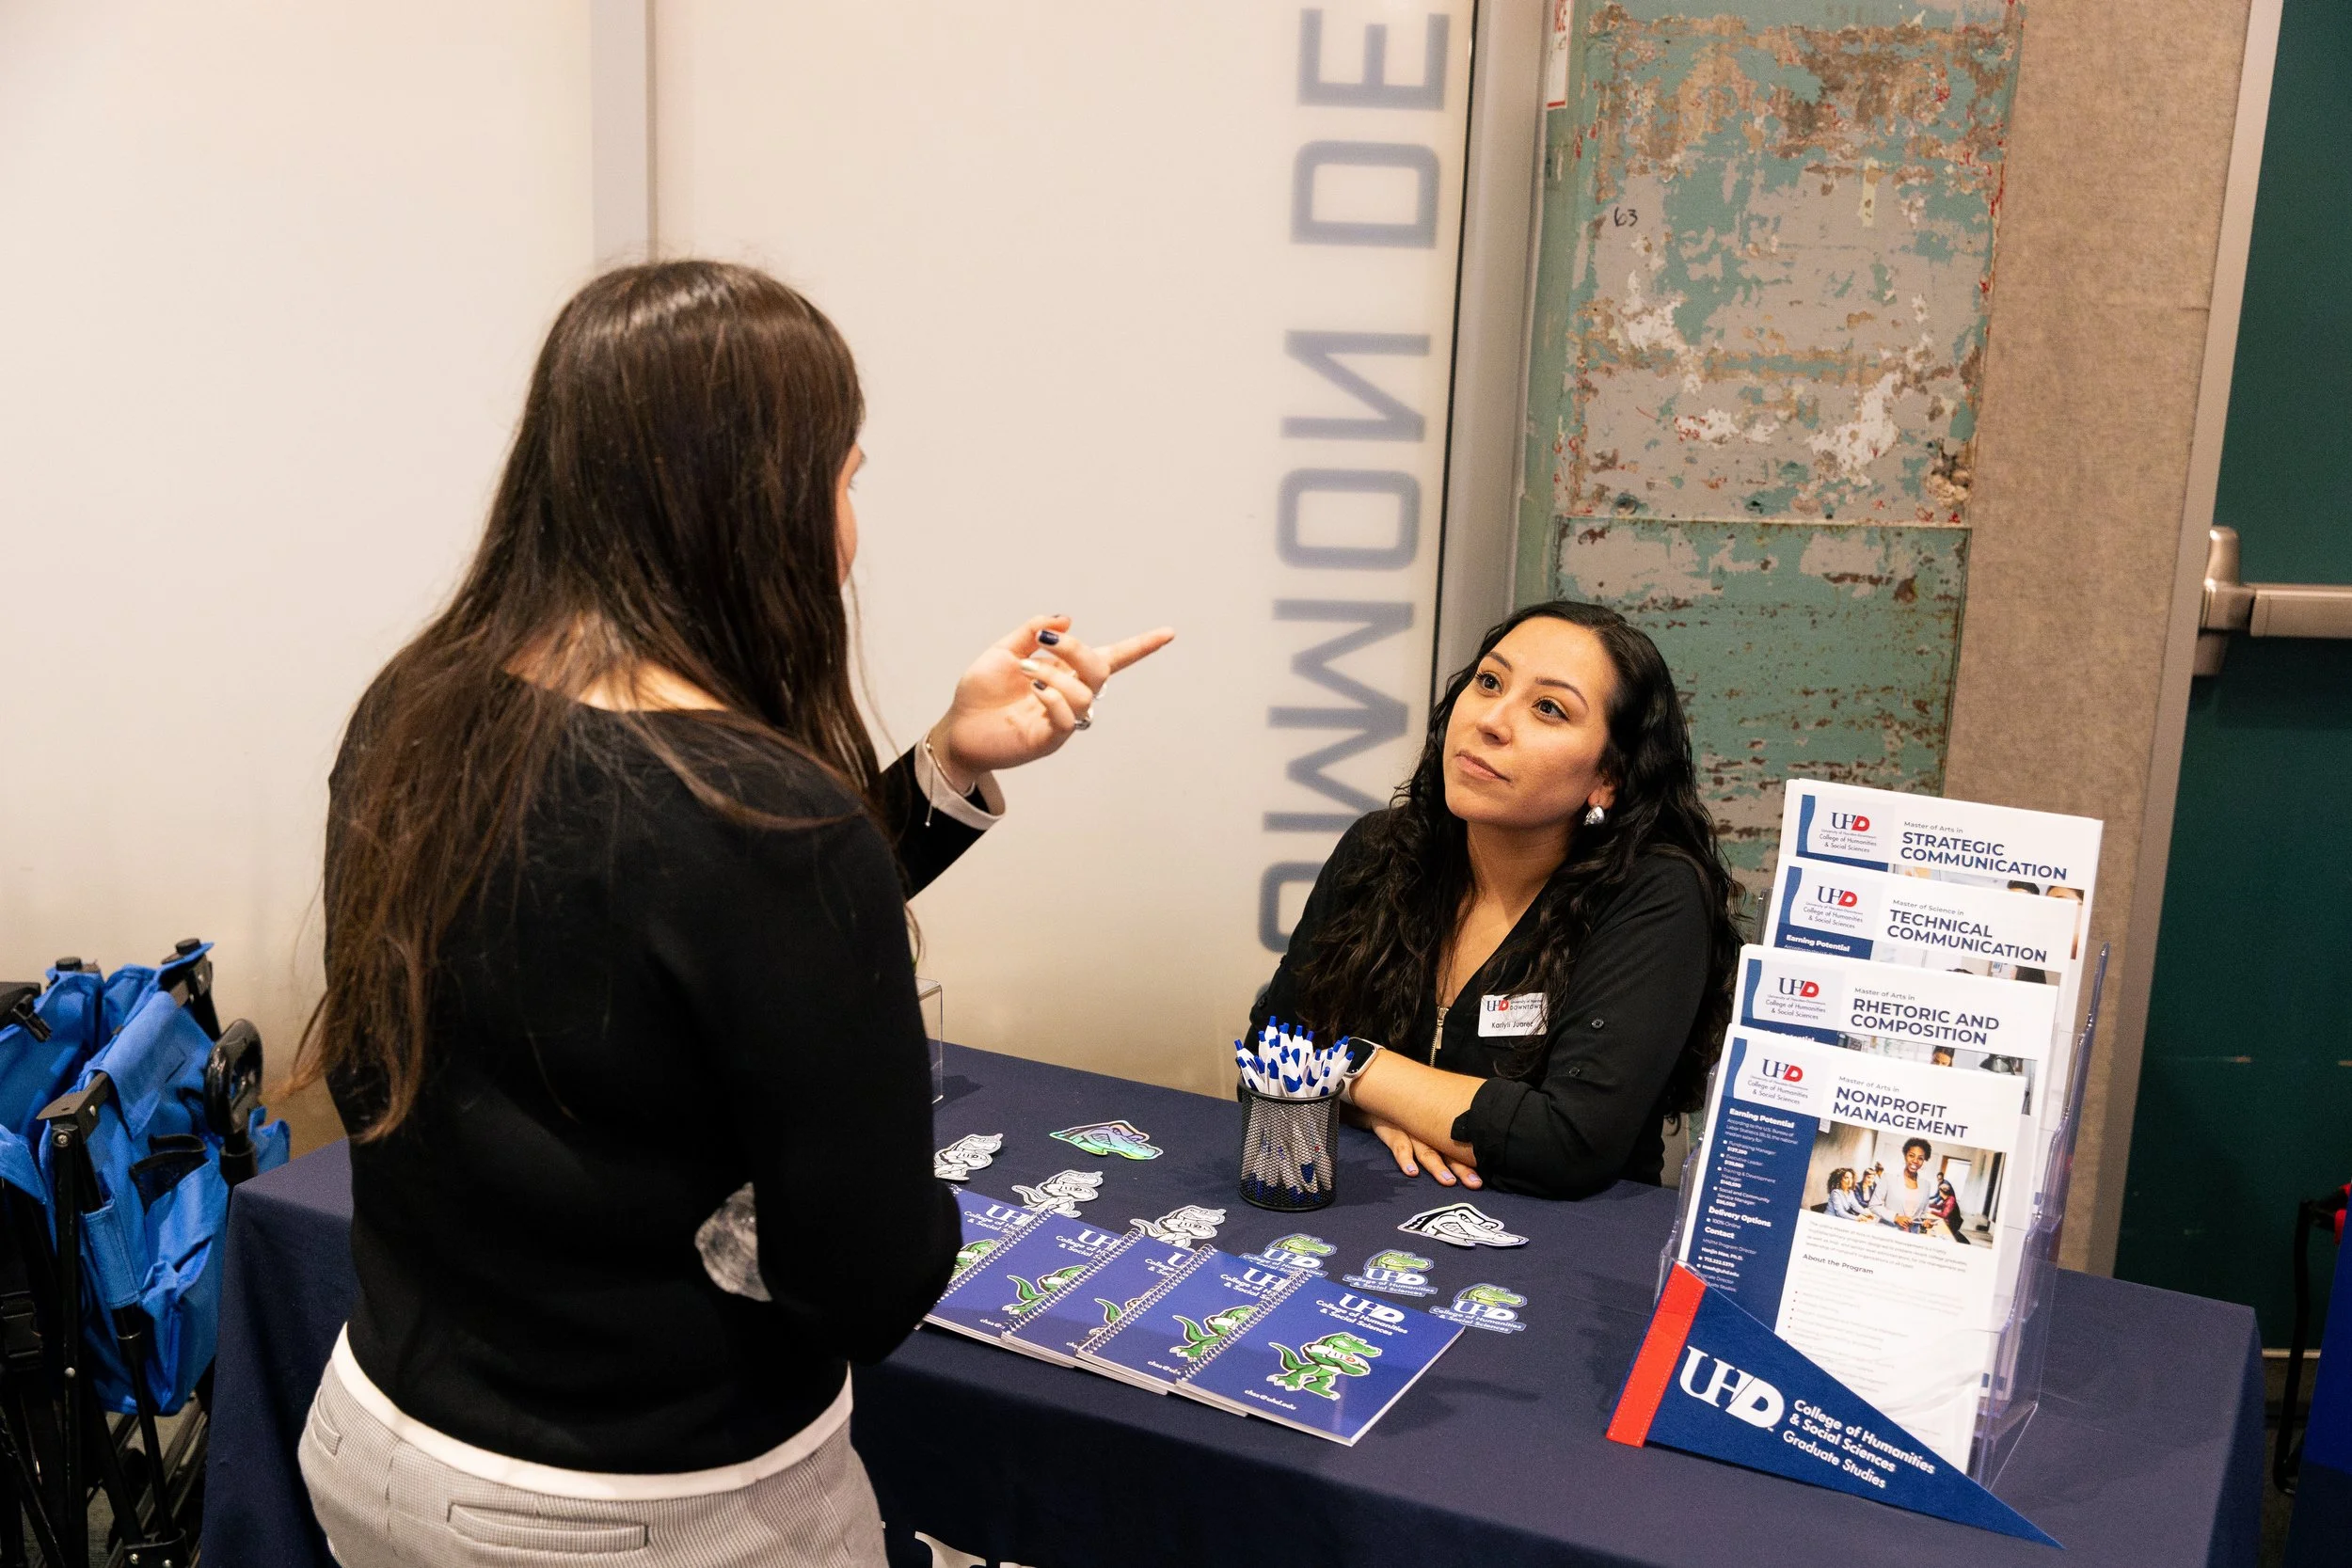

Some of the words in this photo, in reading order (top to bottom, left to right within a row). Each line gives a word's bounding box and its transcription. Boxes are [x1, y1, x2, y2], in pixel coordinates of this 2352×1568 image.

[1613, 206, 1638, 227] 63
[1832, 812, 1869, 832] UHD
[1820, 833, 1839, 842] College
[1847, 838, 1877, 847] Humanities
[1848, 845, 1869, 853] Sciences
[1902, 832, 2005, 856] STRATEGIC
[1900, 847, 2067, 880] COMMUNICATION
[1818, 886, 1857, 907] UHD
[1893, 899, 1917, 908] Master
[1929, 905, 1956, 914] Science
[1804, 907, 1823, 915] College
[1832, 911, 1863, 923] Humanities
[1832, 919, 1855, 928] Sciences
[1890, 909, 1993, 938] TECHNICAL
[1786, 935, 1815, 946] Earning
[1816, 940, 1851, 952] Potential
[1887, 925, 2047, 963] COMMUNICATION
[1779, 977, 1820, 998] UHD
[1486, 999, 1509, 1011] UHD
[1766, 999, 1787, 1008] College
[1795, 1004, 1826, 1013] Humanities
[1795, 1011, 1819, 1020] Sciences
[1853, 998, 1950, 1023] RHETORIC
[1955, 1013, 1999, 1030] AND
[1851, 1014, 1987, 1045] COMPOSITION
[1762, 1059, 1803, 1082] UHD
[1839, 1076, 1864, 1085] Master
[1747, 1080, 1769, 1089] College
[1777, 1086, 1808, 1099] Humanities
[1759, 1090, 1776, 1099] Social
[1777, 1094, 1800, 1104] Sciences
[1836, 1086, 1947, 1117] NONPROFIT
[1729, 1108, 1759, 1121] Earning
[1759, 1115, 1795, 1129] Potential
[1833, 1101, 1968, 1138] MANAGEMENT
[1708, 1206, 1740, 1221] Delivery
[1740, 1214, 1772, 1227] Options
[1705, 1227, 1735, 1239] Contact
[1263, 1248, 1321, 1268] UHD
[1803, 1254, 1826, 1263] About
[1842, 1262, 1873, 1274] Program
[1220, 1274, 1252, 1288] College
[1366, 1268, 1426, 1285] UHD
[1316, 1300, 1349, 1314] College
[1359, 1315, 1408, 1334] Humanities
[1338, 1292, 1406, 1323] UHD
[1454, 1301, 1516, 1323] UHD
[1329, 1311, 1357, 1323] Social
[1357, 1321, 1393, 1336] Sciences
[1679, 1345, 1785, 1428] UHD
[1789, 1413, 1800, 1426] &
[1802, 1418, 1841, 1445] Social
[1841, 1438, 1896, 1472] Sciences
[1794, 1400, 1842, 1430] College
[1846, 1426, 1862, 1437] of
[1861, 1431, 1935, 1474] Humanities
[1783, 1430, 1840, 1465] Graduate
[1842, 1459, 1885, 1488] Studies
